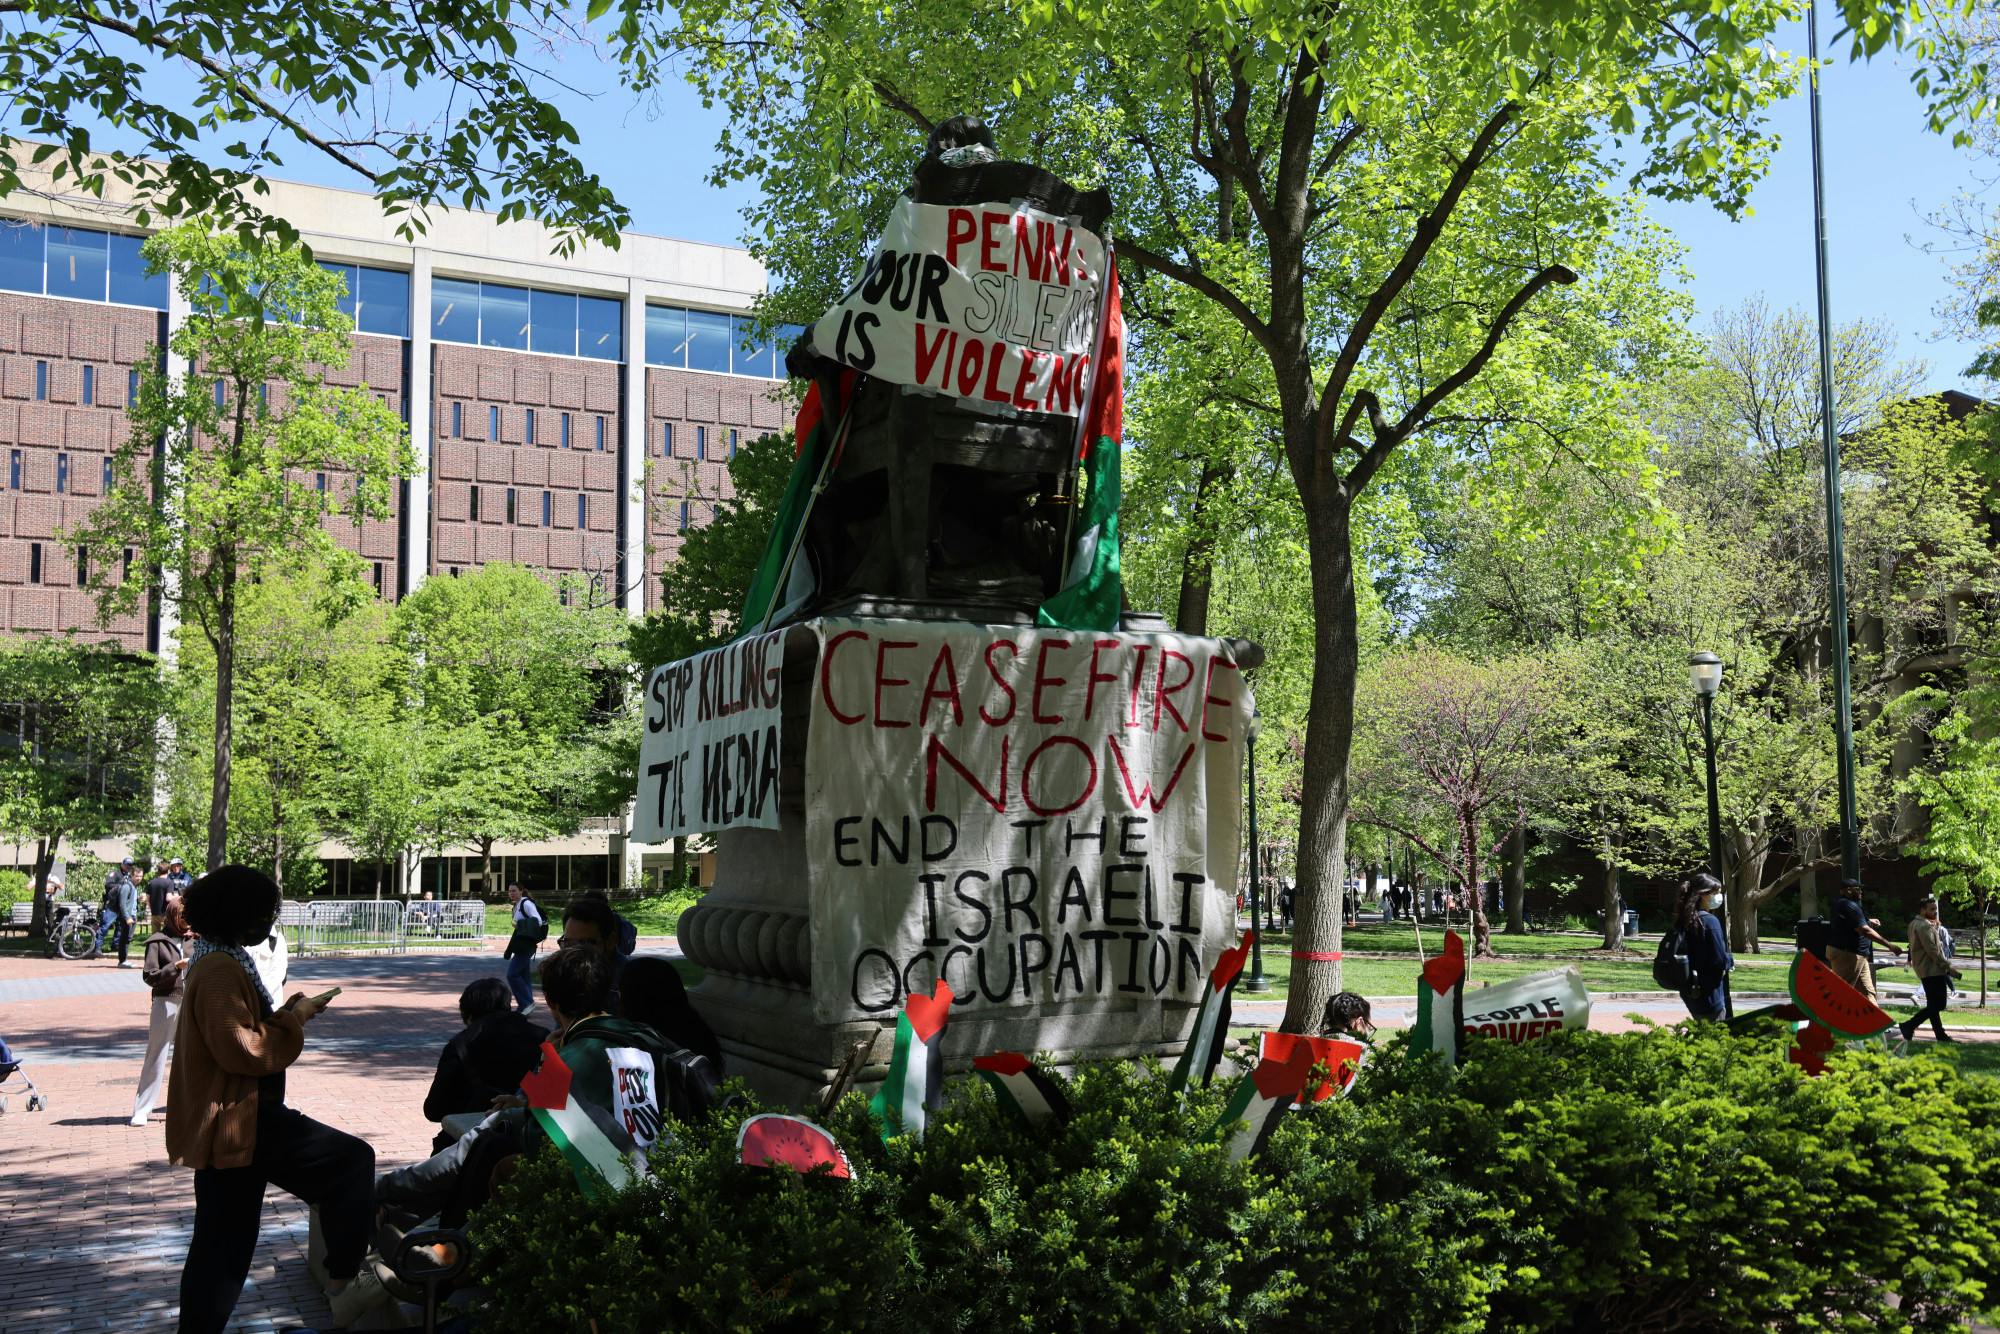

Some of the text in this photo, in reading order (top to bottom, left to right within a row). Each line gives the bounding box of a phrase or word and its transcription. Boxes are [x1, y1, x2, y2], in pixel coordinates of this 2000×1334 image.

[835, 309, 881, 371] IS
[837, 249, 1095, 352] YOUR SILEN
[648, 629, 782, 734] STOP KILLING
[820, 630, 1238, 742] CEASEFIRE
[925, 733, 1196, 817] NOW
[834, 815, 1149, 867] END THE
[918, 863, 1206, 947] ISRAELI
[851, 930, 1201, 1012] OCCUPATION
[1463, 996, 1564, 1022] EOPLE
